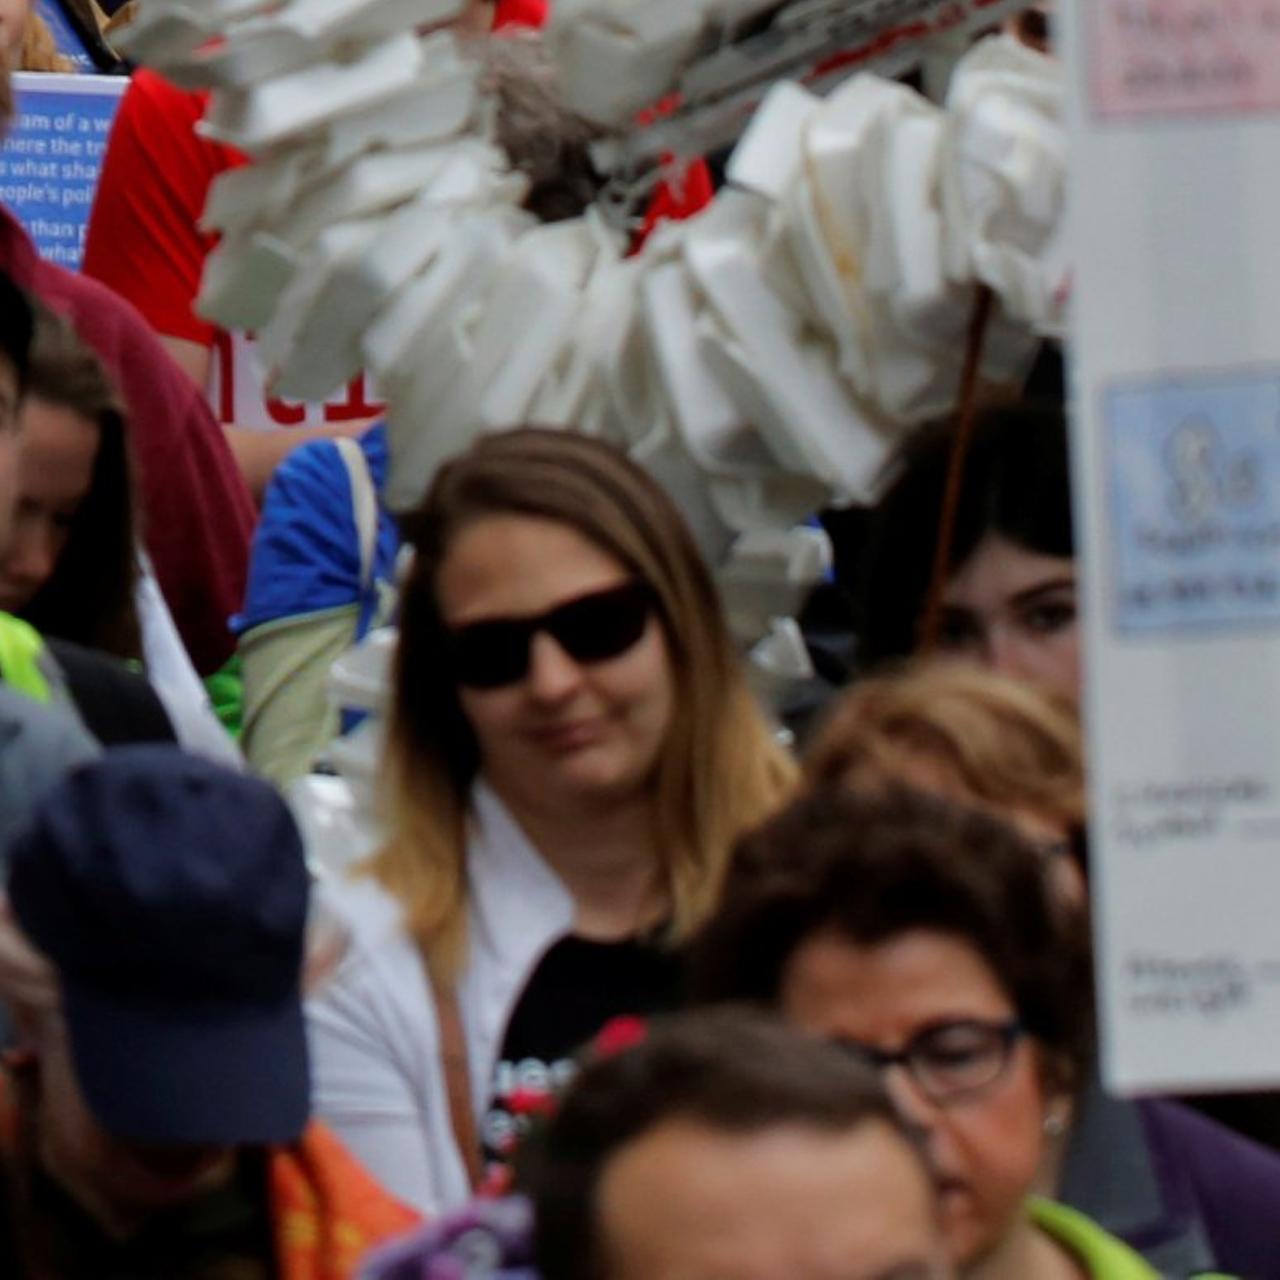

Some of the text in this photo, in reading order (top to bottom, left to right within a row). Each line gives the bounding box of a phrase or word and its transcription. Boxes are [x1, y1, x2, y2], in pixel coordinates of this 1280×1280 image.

[54, 112, 90, 130] of a
[51, 138, 83, 155] the
[10, 159, 58, 178] what
[30, 219, 74, 237] than
